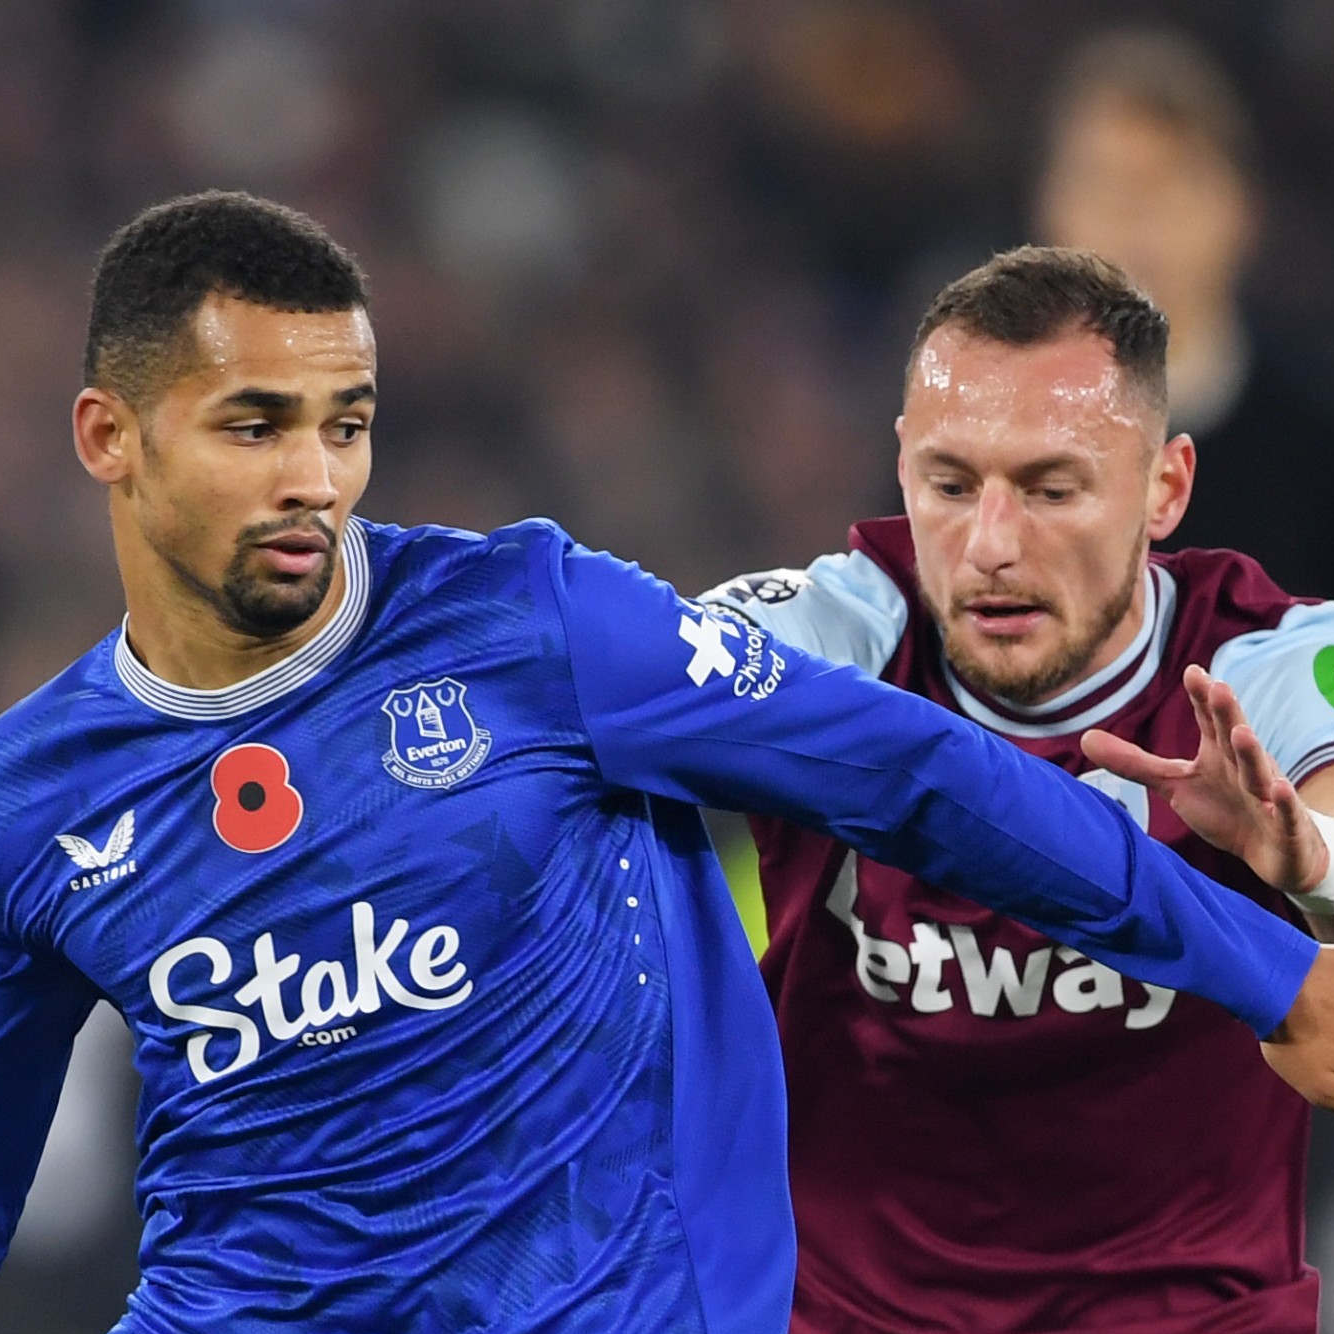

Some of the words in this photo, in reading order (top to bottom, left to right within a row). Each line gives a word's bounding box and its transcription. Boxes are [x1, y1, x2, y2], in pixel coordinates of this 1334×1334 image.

[406, 738, 467, 761] Everton
[70, 860, 137, 891] CASTORE
[148, 901, 473, 1083] Stake
[297, 1023, 357, 1047] .com
